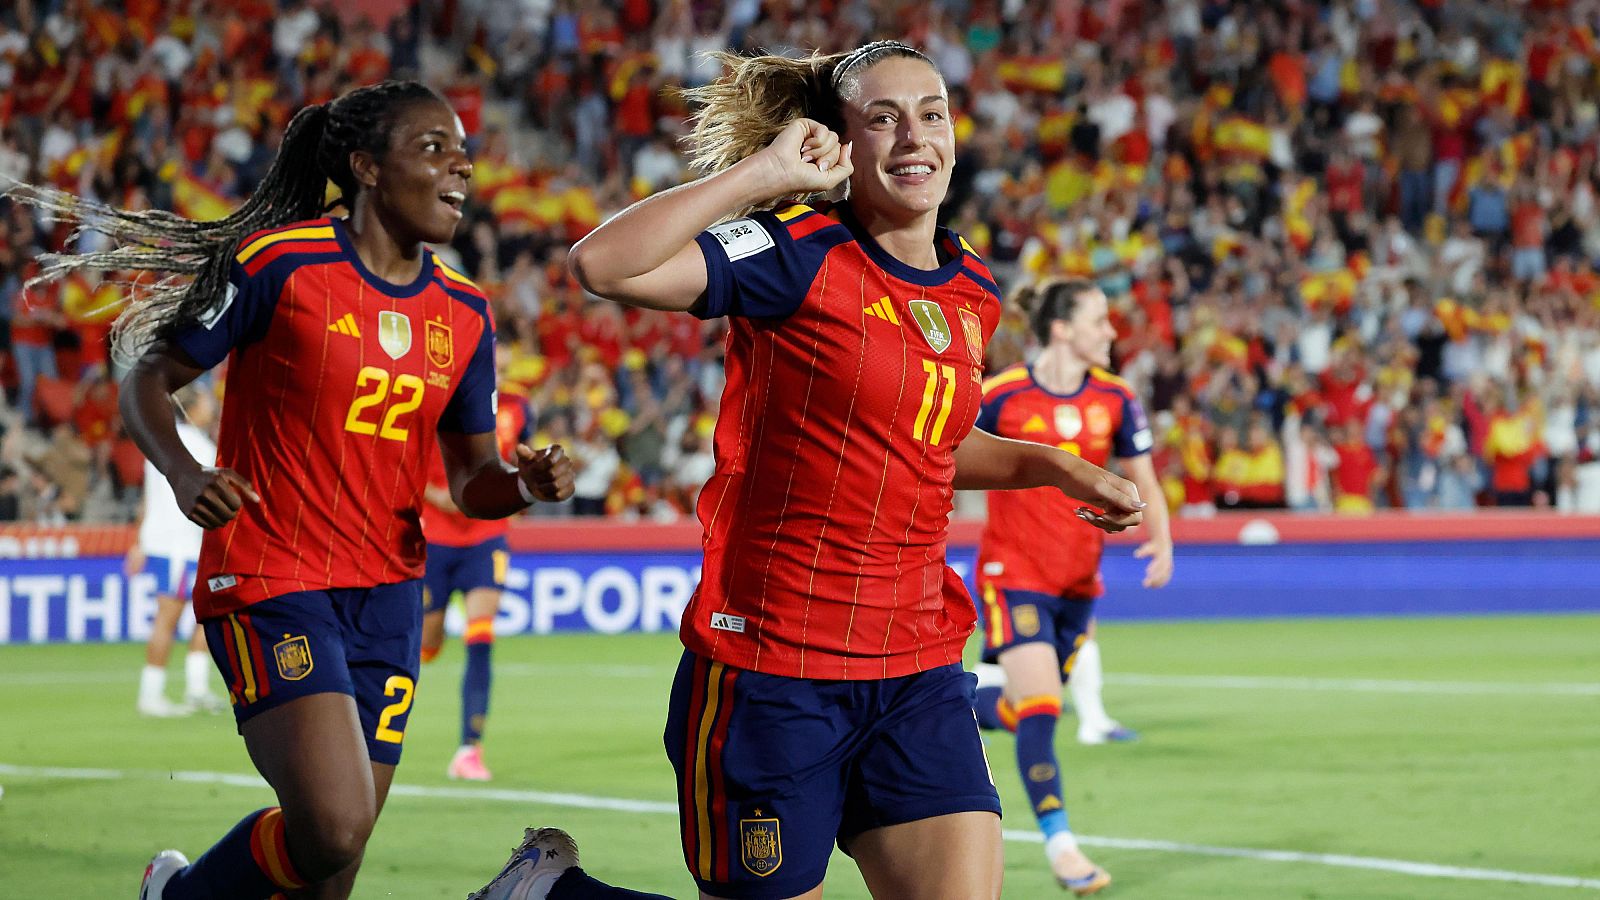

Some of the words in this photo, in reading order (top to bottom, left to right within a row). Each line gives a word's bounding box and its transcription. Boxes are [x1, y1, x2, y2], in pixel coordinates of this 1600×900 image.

[344, 366, 424, 441] 22
[913, 359, 956, 446] 11
[491, 566, 702, 634] SPOR
[375, 675, 414, 744] 2
